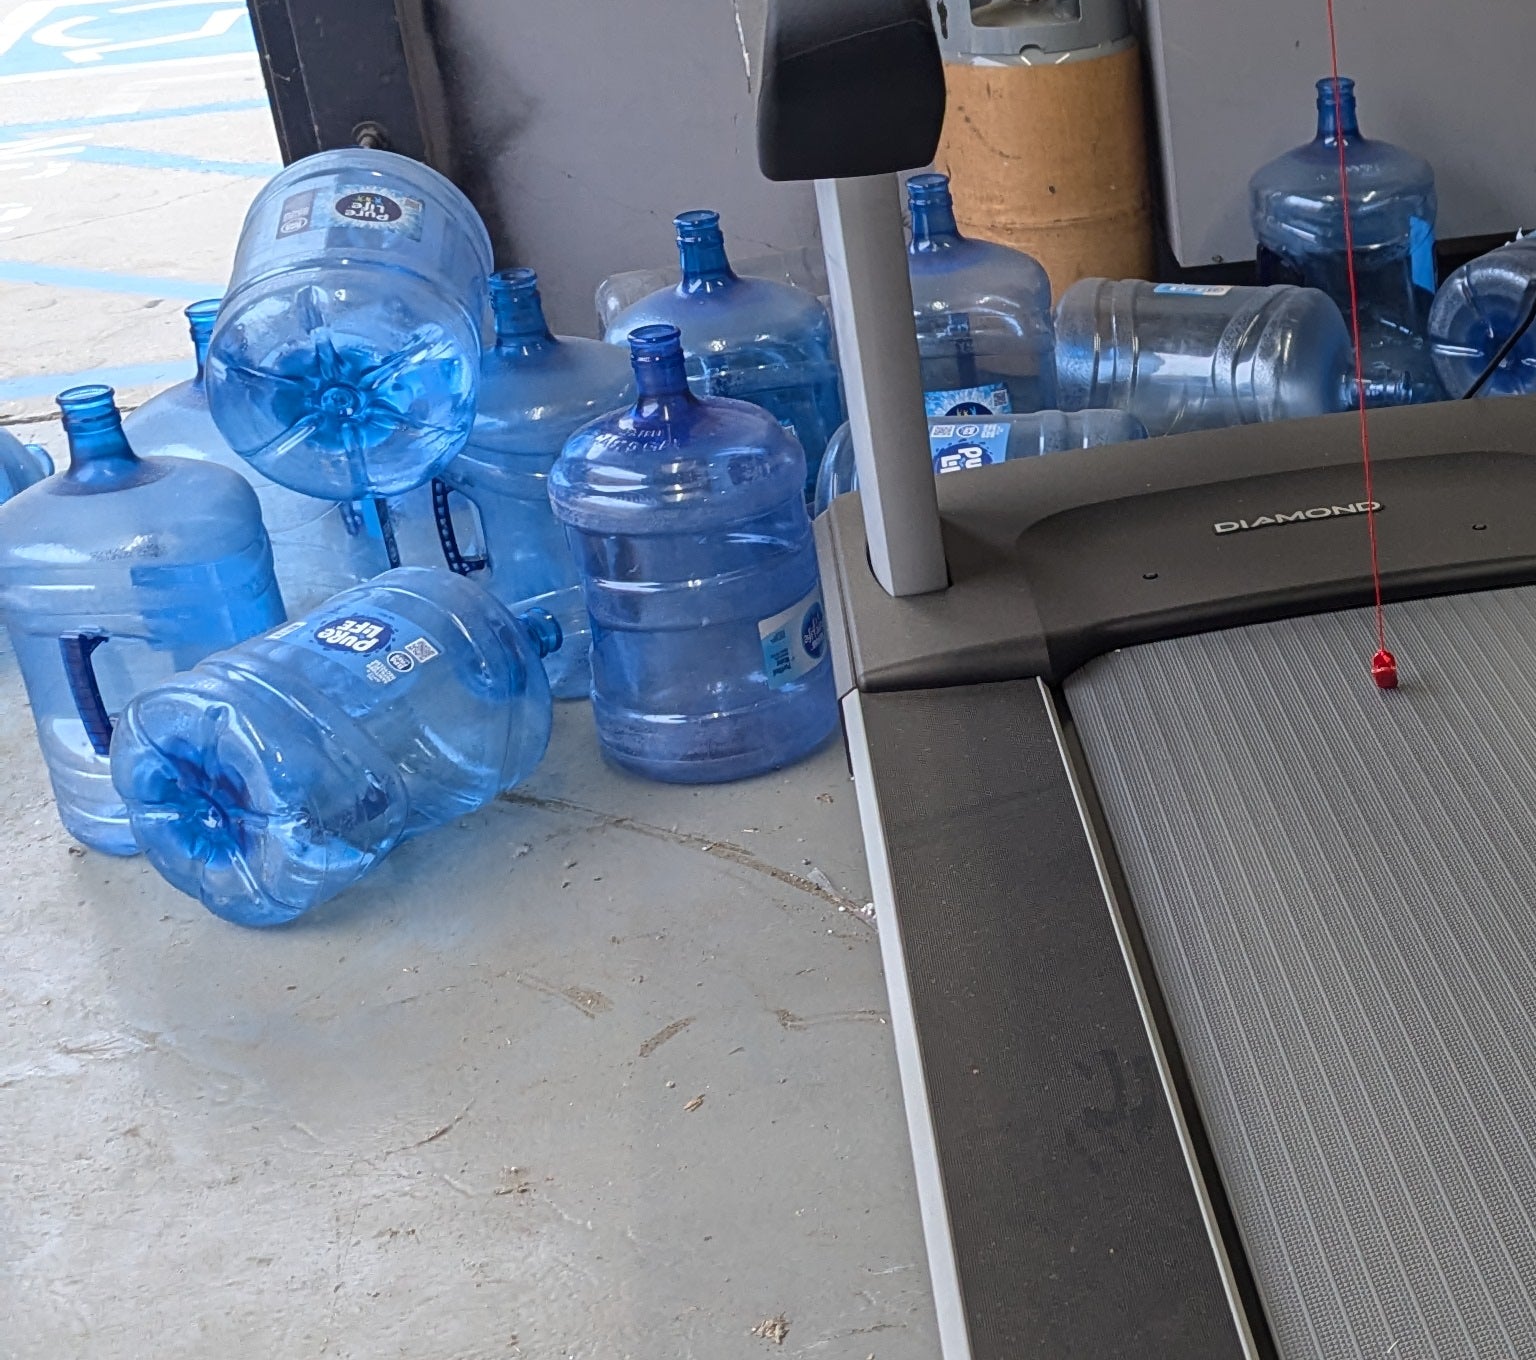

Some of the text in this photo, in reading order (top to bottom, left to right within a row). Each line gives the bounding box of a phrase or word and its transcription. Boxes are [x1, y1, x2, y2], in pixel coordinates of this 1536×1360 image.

[351, 201, 385, 213] Life
[345, 209, 389, 221] Pure
[1213, 501, 1382, 533] DIAMOND
